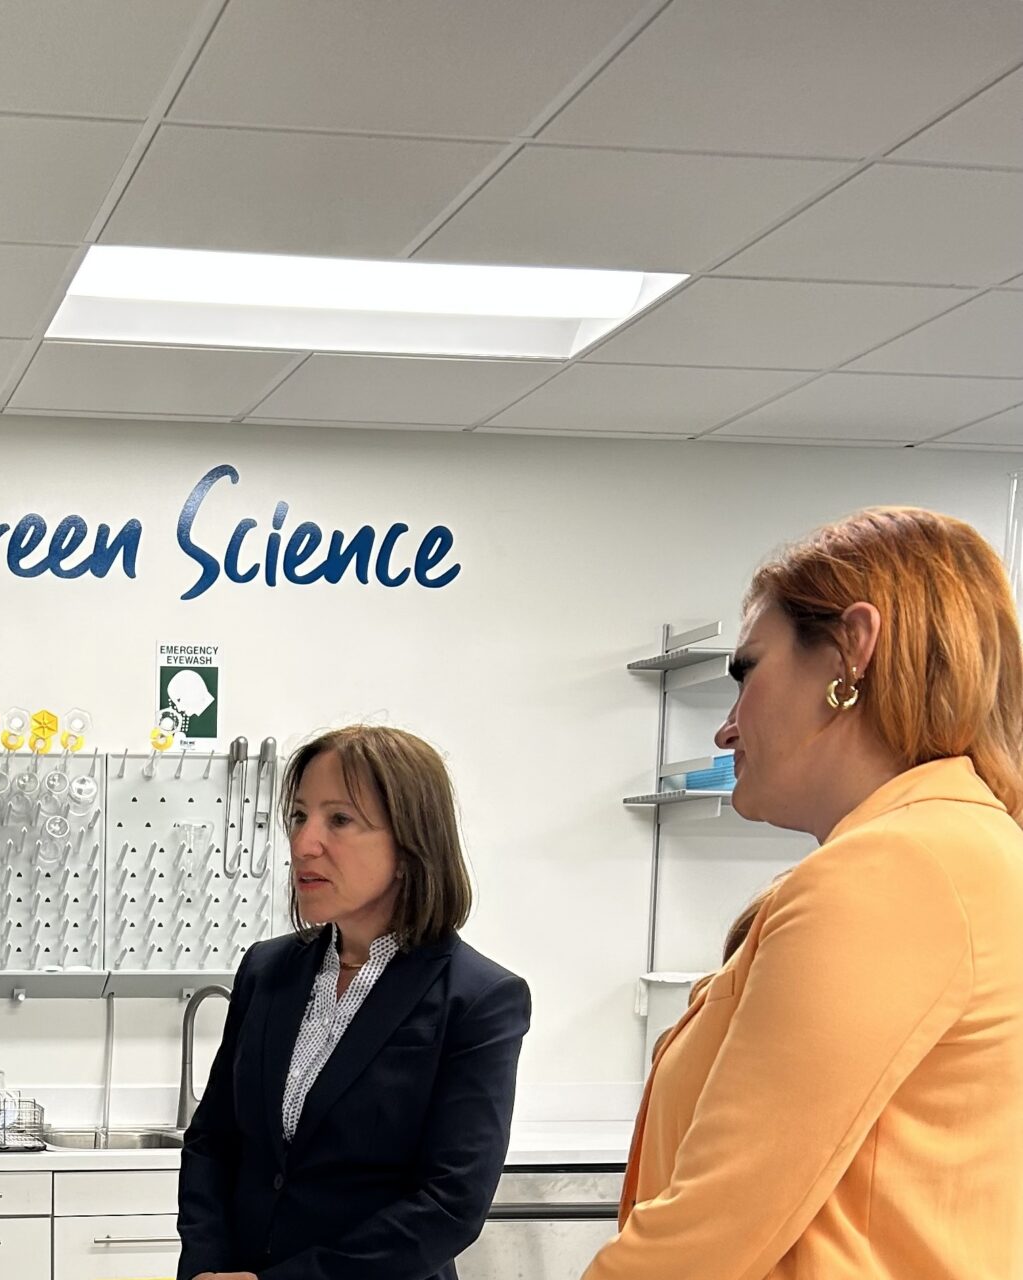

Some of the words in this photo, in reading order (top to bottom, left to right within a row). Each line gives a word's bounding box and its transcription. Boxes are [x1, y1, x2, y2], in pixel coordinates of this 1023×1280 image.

[176, 464, 461, 600] Science
[160, 646, 219, 655] EMERGENCY
[166, 656, 212, 665] EYEWASH
